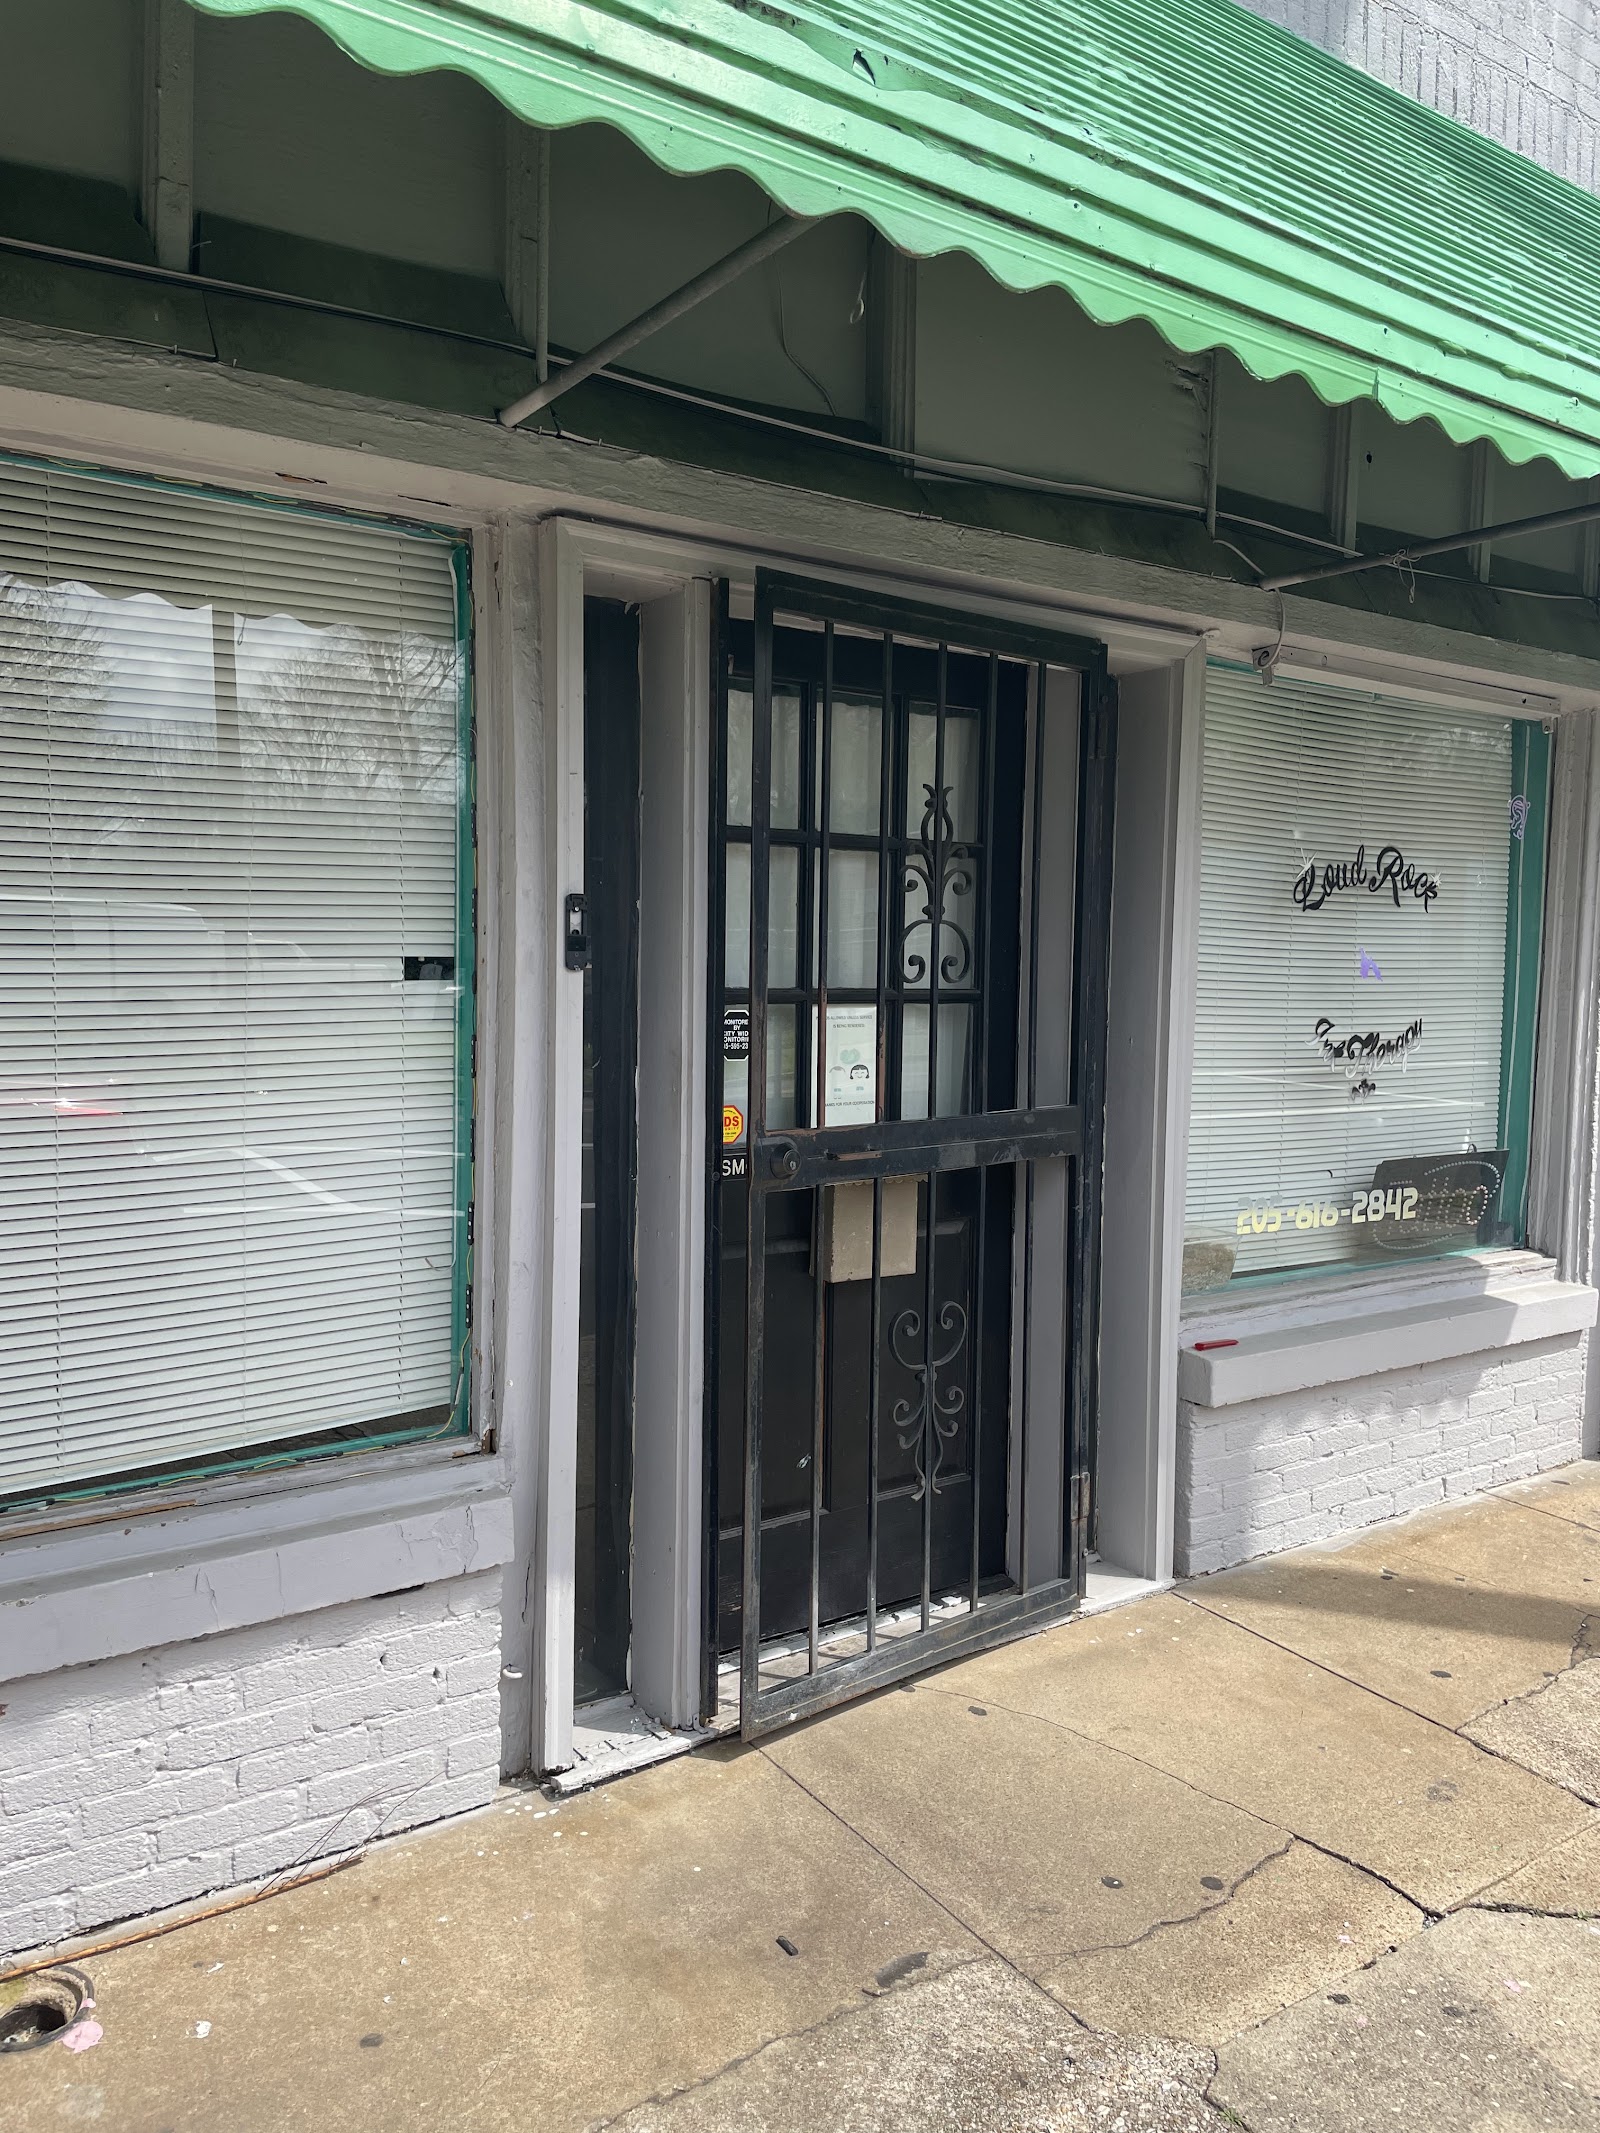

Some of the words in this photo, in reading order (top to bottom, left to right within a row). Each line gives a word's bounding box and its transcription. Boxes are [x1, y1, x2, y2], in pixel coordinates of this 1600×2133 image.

[1293, 844, 1367, 912] Loud
[1345, 1018, 1423, 1079] Therapy
[724, 1115, 739, 1127] DS
[1236, 1186, 1419, 1236] 205-616-2842
